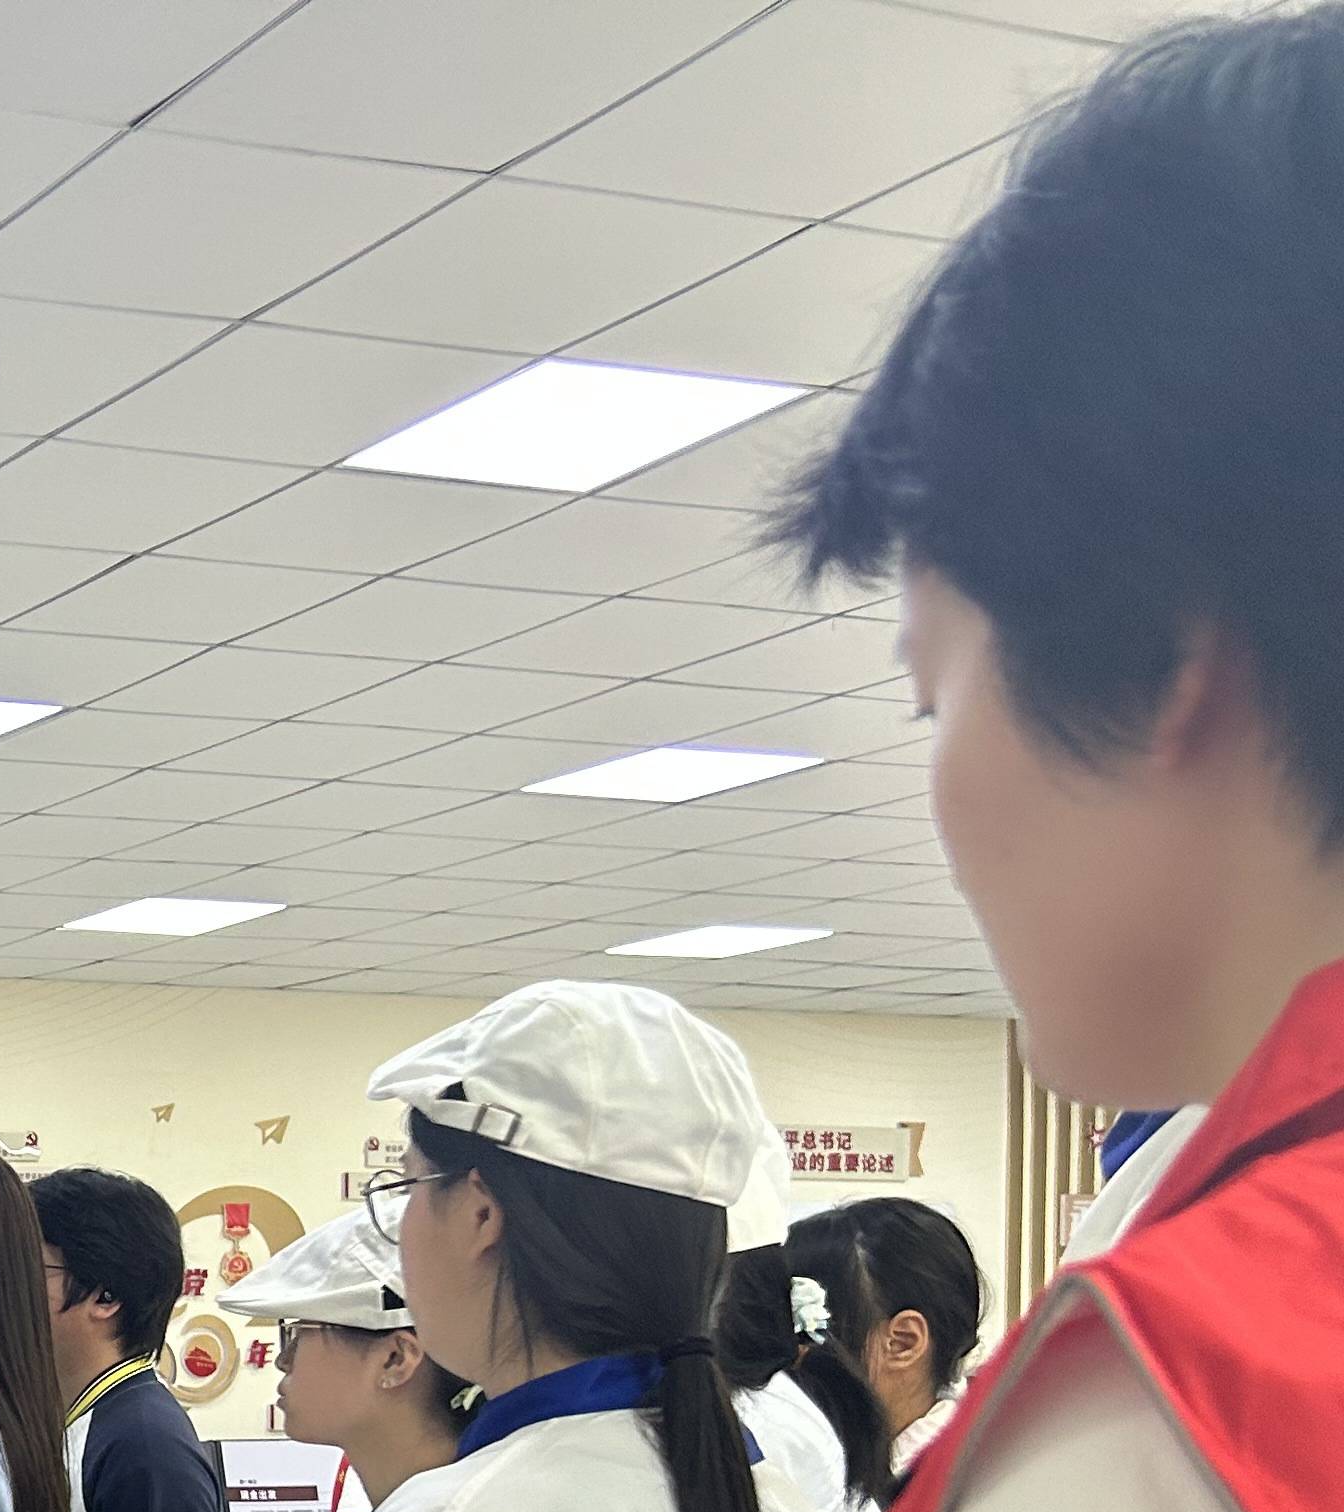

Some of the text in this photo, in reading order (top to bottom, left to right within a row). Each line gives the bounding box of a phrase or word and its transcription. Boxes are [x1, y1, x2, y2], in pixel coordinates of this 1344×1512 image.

[785, 1130, 853, 1151] 平总书记
[792, 1152, 895, 1173] 设的重要论述
